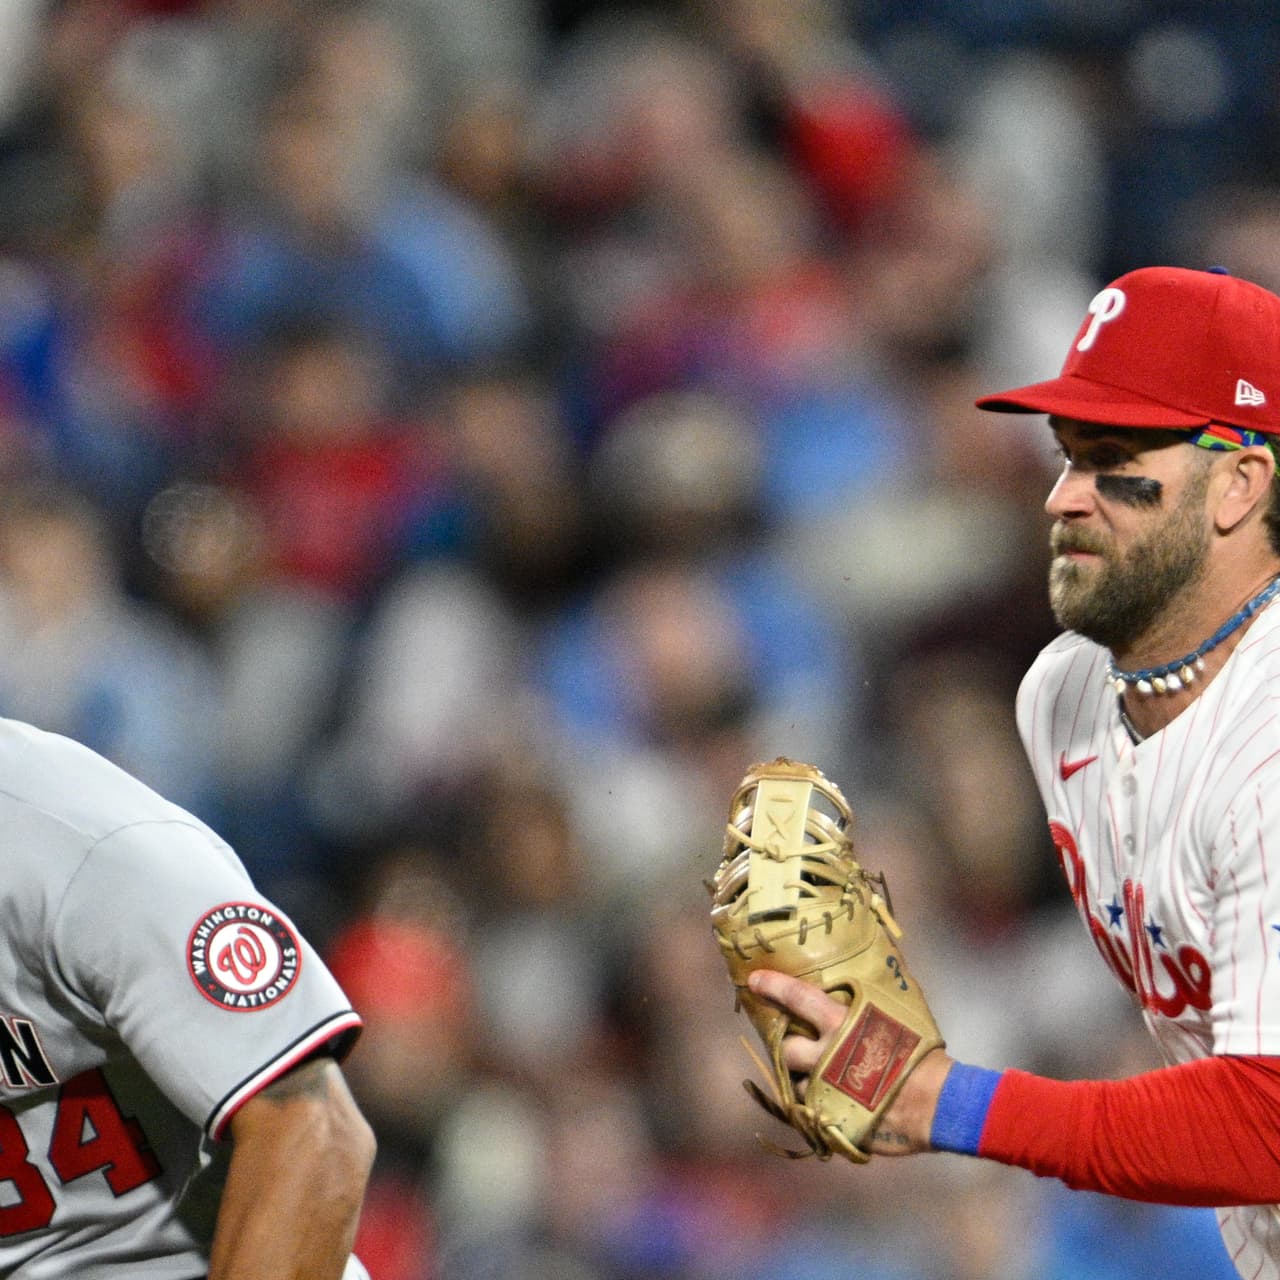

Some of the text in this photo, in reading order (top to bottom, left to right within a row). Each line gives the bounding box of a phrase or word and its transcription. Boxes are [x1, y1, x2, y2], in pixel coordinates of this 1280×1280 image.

[1076, 287, 1126, 352] P
[192, 905, 273, 975] WASHINGTON
[216, 926, 267, 985] W
[223, 947, 297, 1008] NATIONALS
